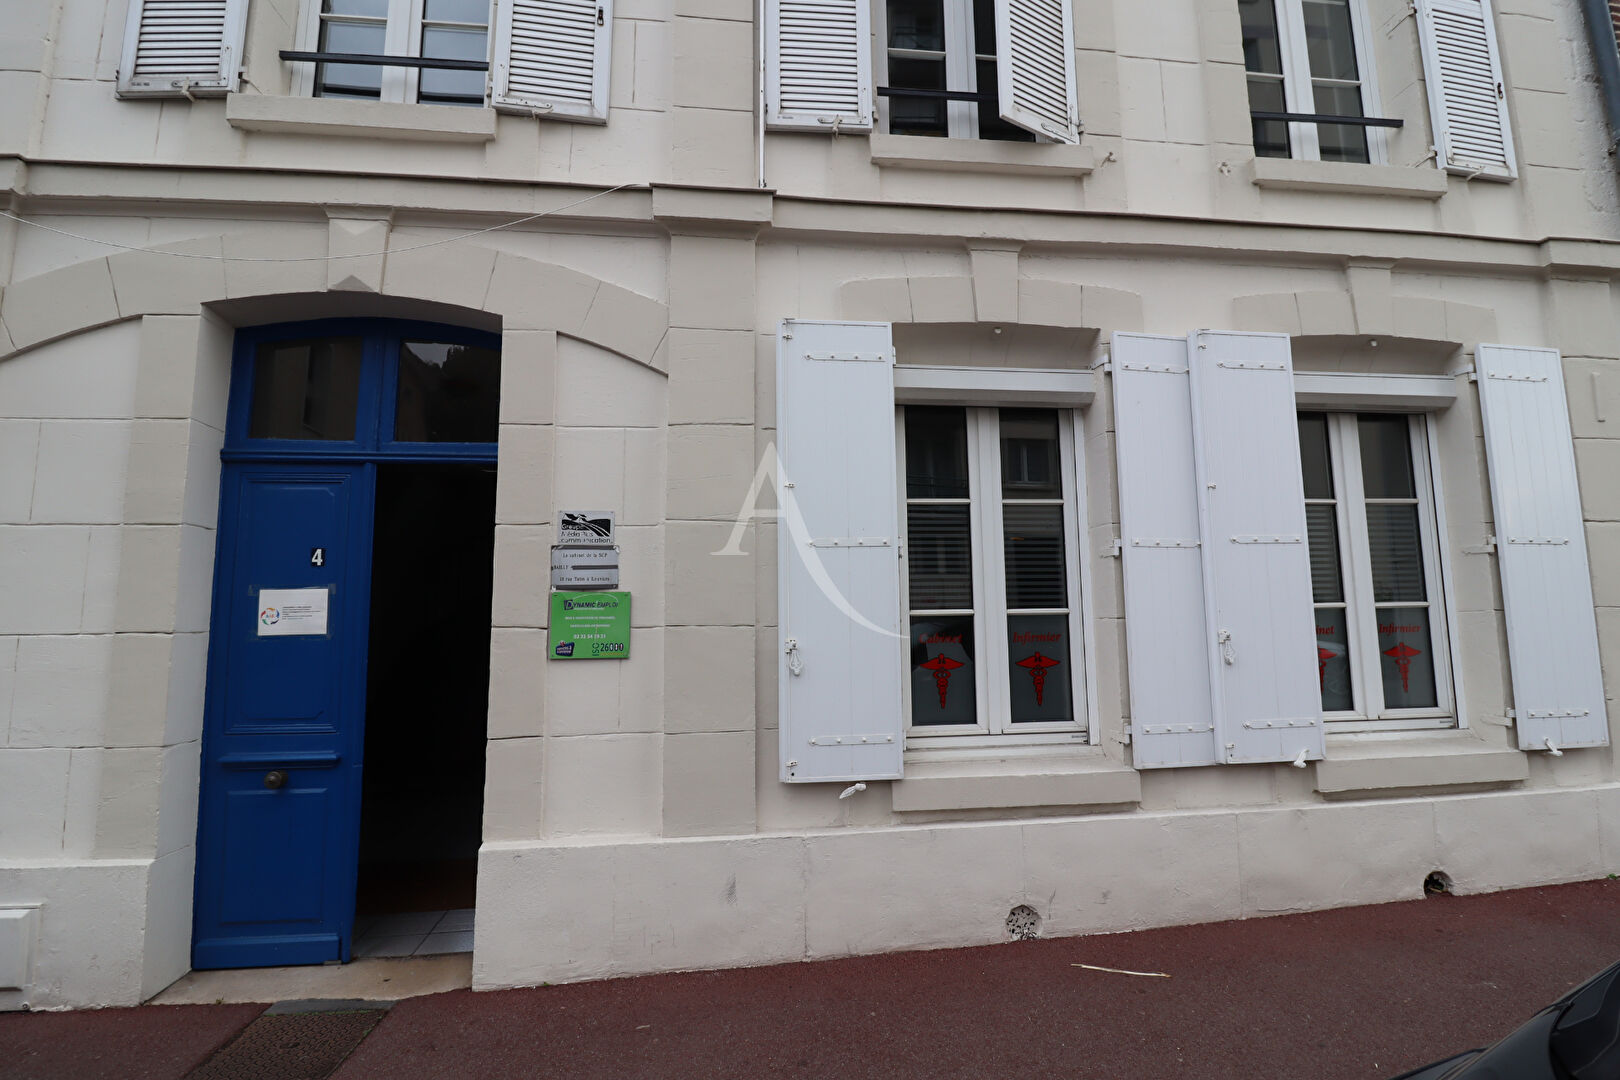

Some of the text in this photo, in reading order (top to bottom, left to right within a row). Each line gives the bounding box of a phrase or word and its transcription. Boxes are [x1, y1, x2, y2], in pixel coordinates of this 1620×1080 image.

[311, 548, 323, 566] 4
[564, 600, 619, 610] DYNAMIC EMPLOI
[1316, 622, 1422, 636] inet Infirmier
[919, 631, 1062, 646] Cabinet Infirmier
[600, 642, 624, 652] 26000
